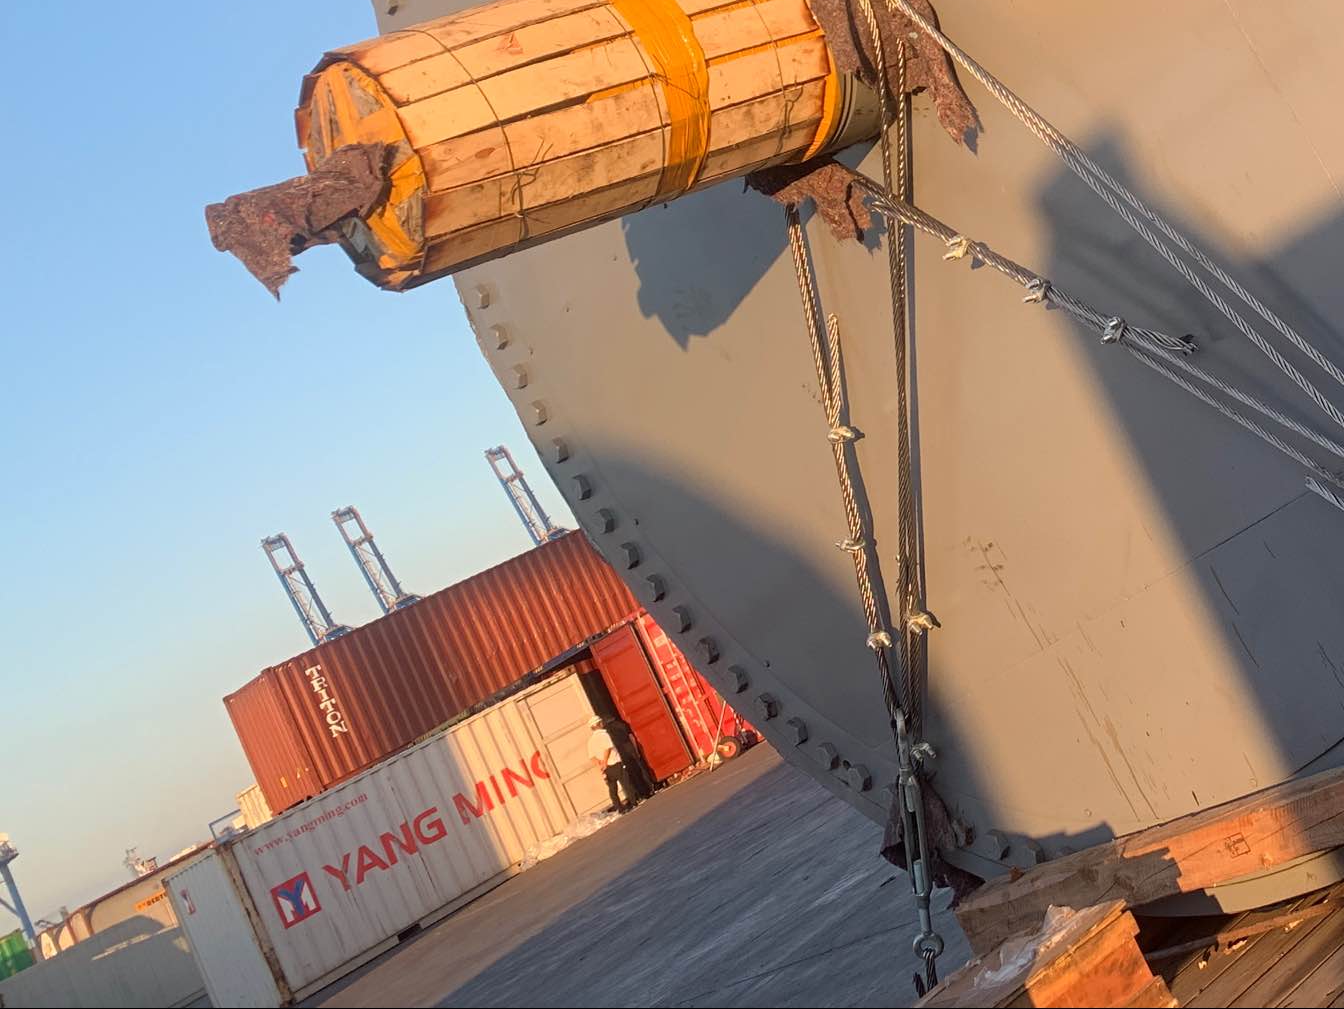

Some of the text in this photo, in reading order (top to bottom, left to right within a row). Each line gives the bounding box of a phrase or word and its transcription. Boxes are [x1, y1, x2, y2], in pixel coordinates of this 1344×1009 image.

[305, 664, 348, 738] TRITON
[254, 792, 368, 856] www.yangming.com
[321, 806, 448, 892] YANG
